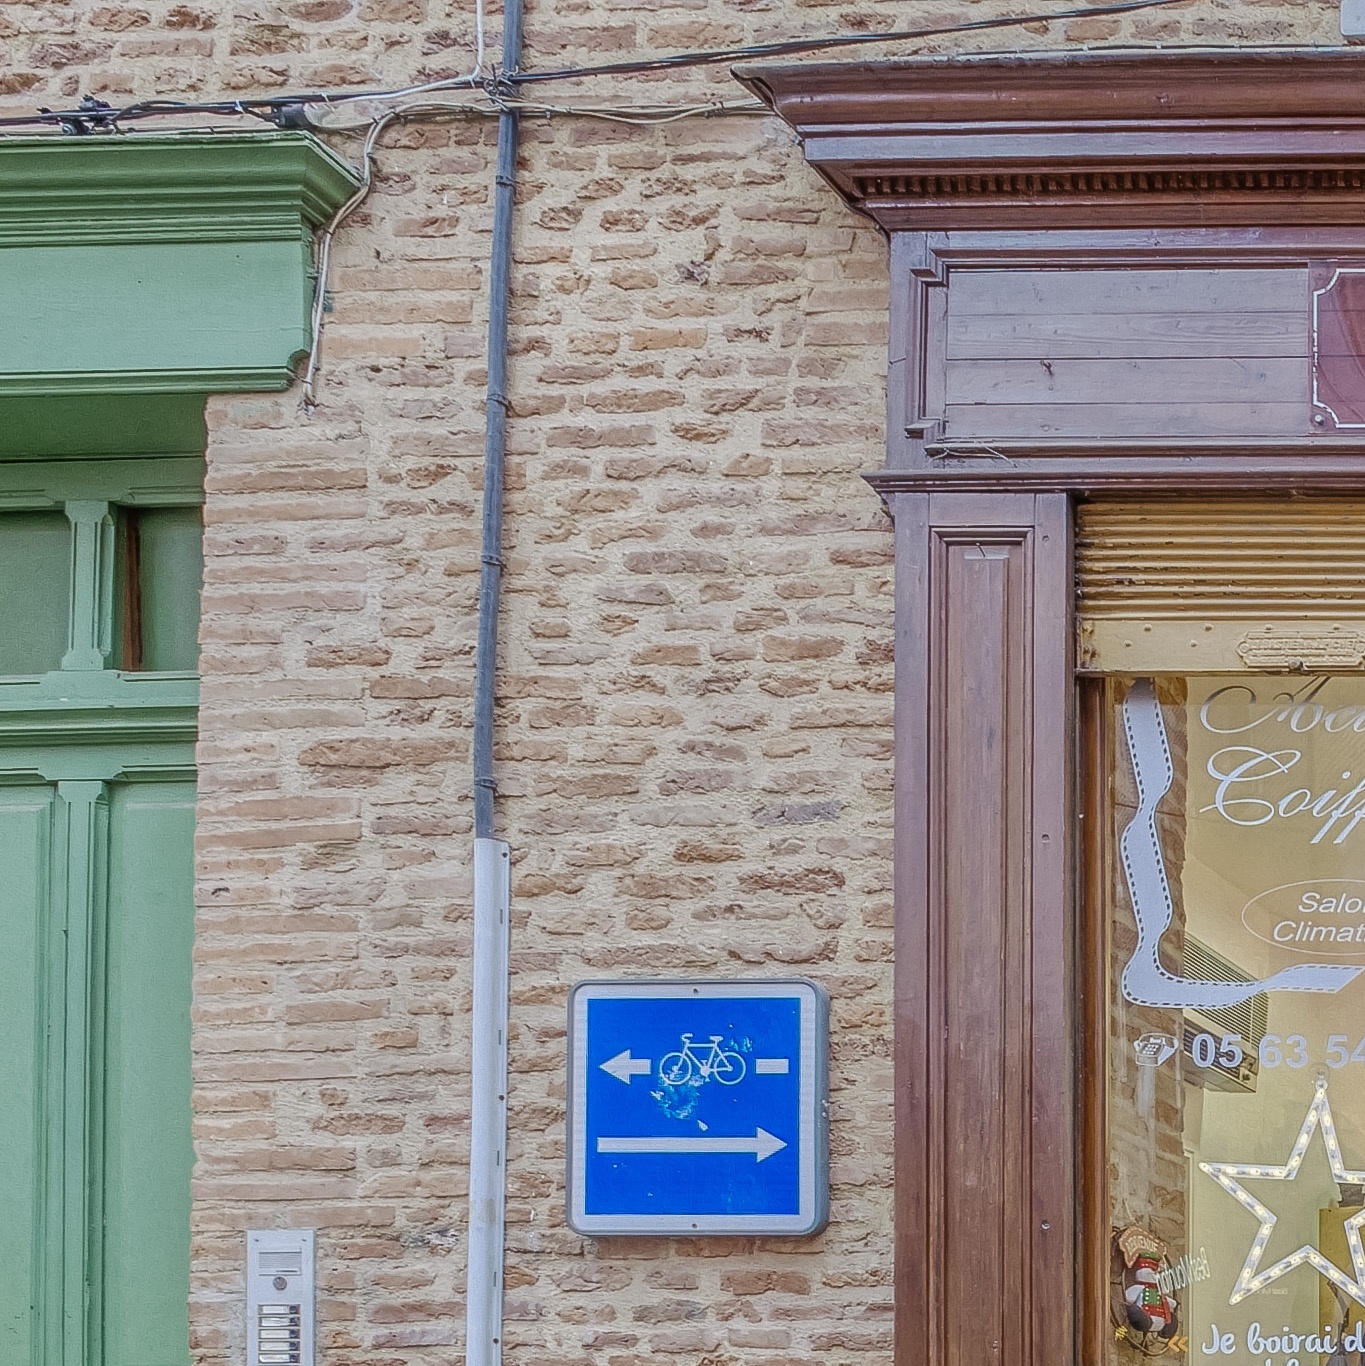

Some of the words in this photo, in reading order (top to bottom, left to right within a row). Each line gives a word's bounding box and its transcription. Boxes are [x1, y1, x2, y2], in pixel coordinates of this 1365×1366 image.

[1192, 1034, 1243, 1068] 05
[1259, 1034, 1308, 1068] 63
[1202, 1323, 1236, 1354] Je
[1247, 1321, 1337, 1354] boirai
